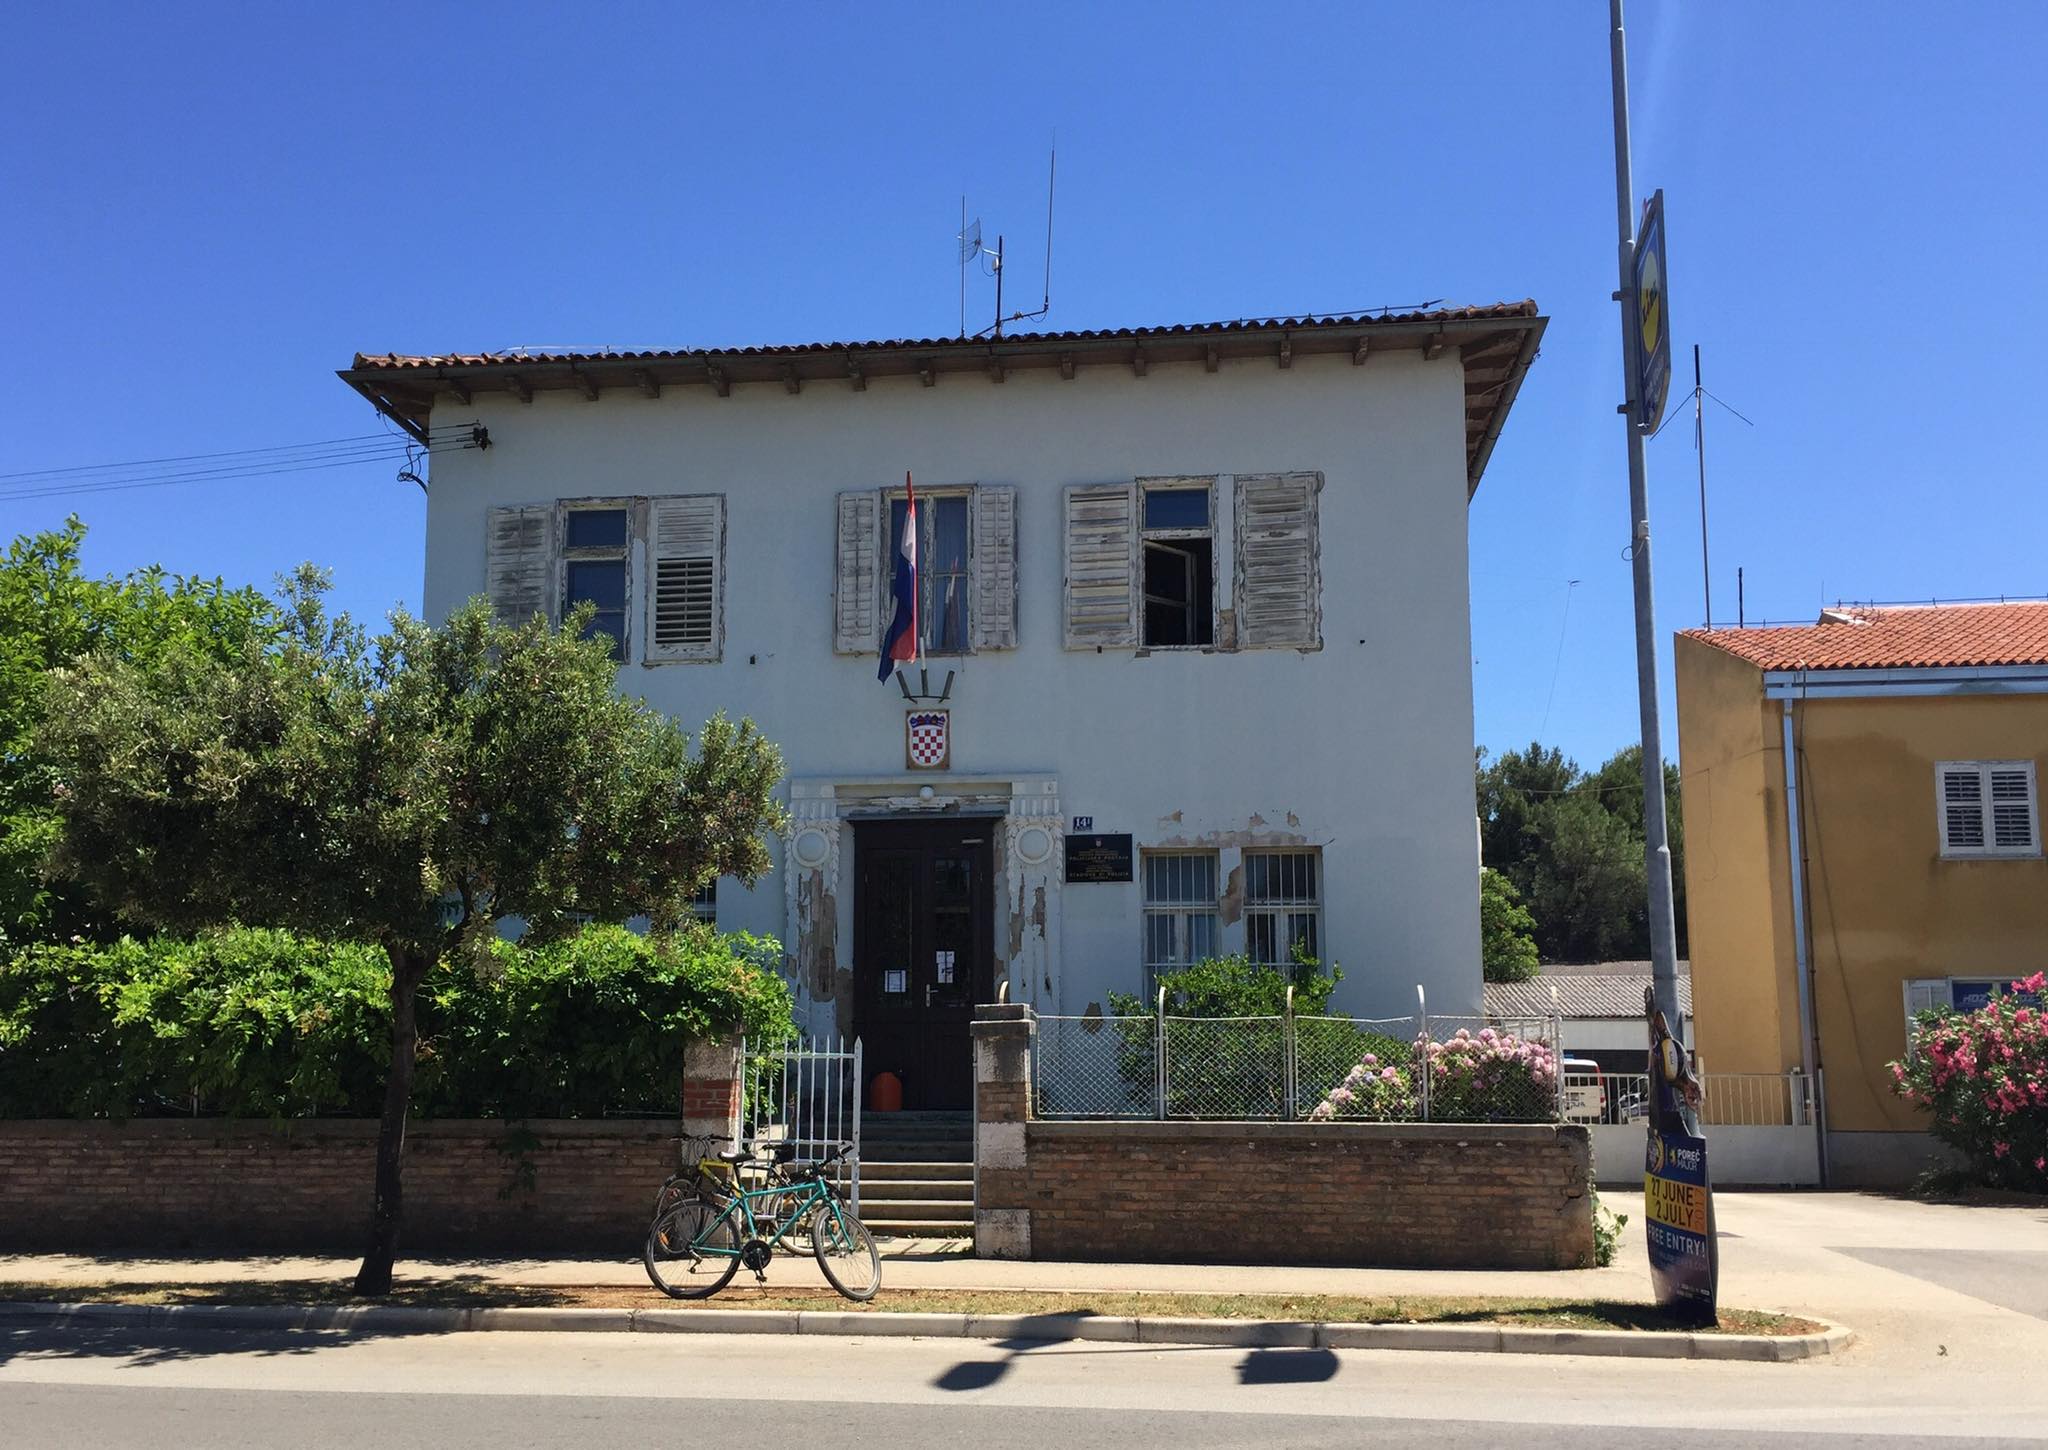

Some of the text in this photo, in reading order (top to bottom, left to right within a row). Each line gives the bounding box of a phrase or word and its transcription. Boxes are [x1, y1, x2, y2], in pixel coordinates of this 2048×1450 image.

[1677, 1149, 1700, 1161] POREČ
[1677, 1159, 1697, 1171] MAJOR
[1651, 1177, 1693, 1206] 27 JUNE
[1656, 1200, 1694, 1228] 2 JULY
[1648, 1223, 1705, 1258] FREE ENTRY!
